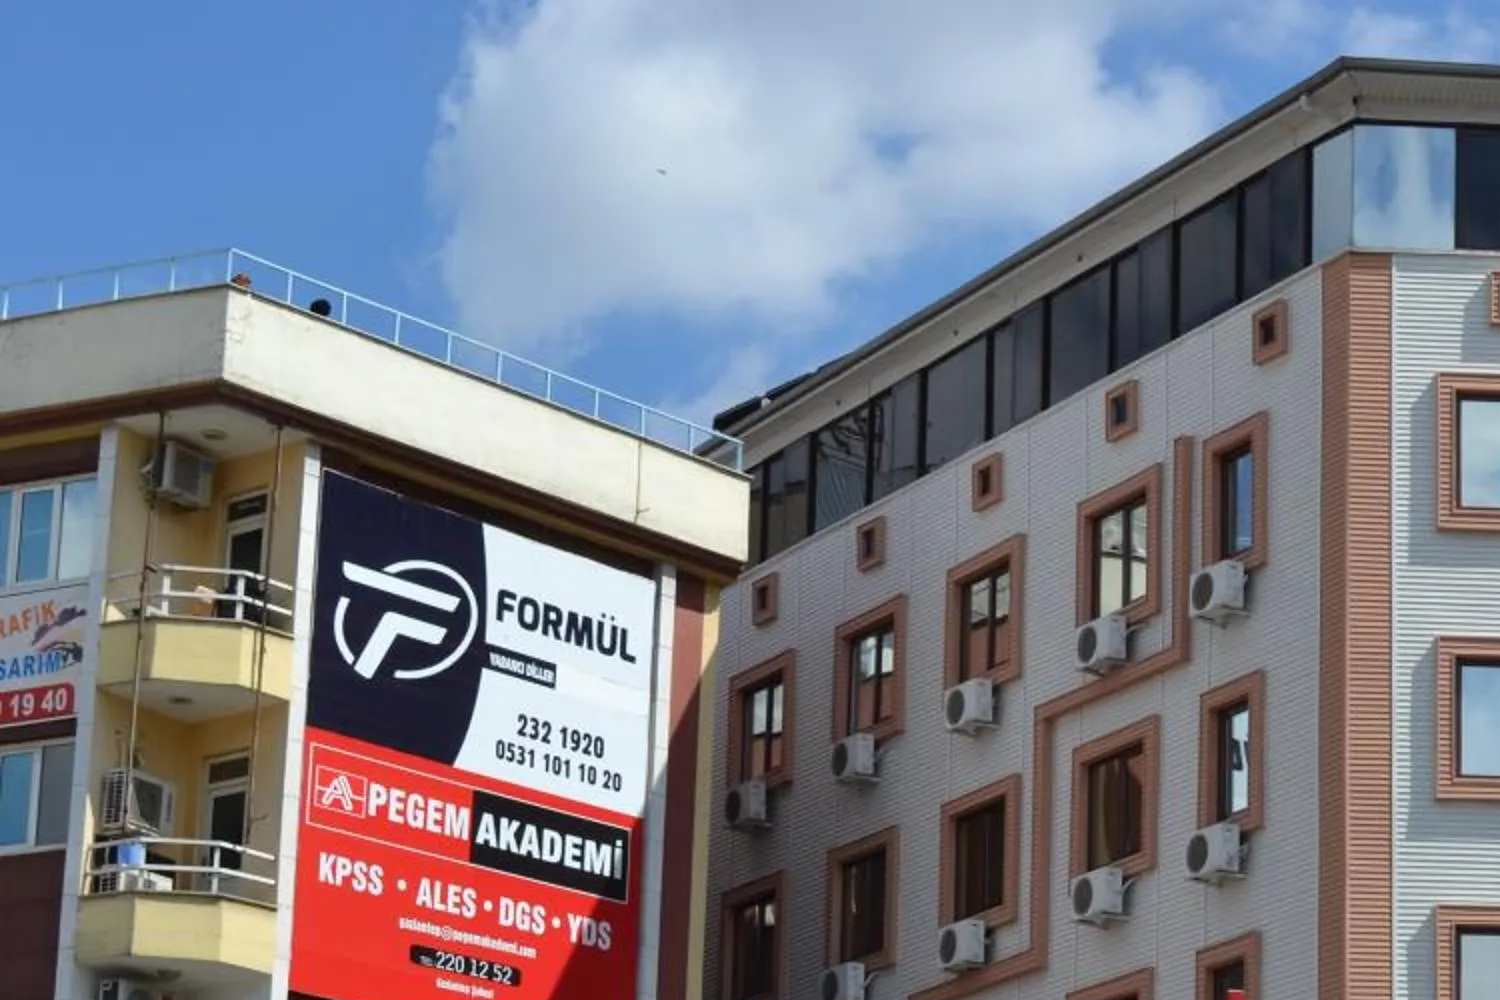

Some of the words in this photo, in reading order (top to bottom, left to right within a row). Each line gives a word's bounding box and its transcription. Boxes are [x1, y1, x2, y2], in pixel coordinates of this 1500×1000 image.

[496, 589, 636, 665] FORMÜL
[10, 692, 35, 718] 19
[41, 687, 68, 713] 40
[517, 713, 551, 745] 232
[560, 726, 605, 759] 1920
[496, 739, 535, 769] 0531
[544, 753, 571, 779] 101
[578, 763, 597, 786] 10
[602, 770, 622, 793] 20
[367, 783, 470, 842] PEGEM
[475, 811, 624, 880] AKADEMİ
[318, 851, 384, 896] KPSS
[415, 877, 478, 919] ALES
[499, 896, 546, 936] DGS
[567, 912, 612, 951] YDS
[435, 951, 465, 974] 220
[470, 957, 489, 980] 12
[491, 963, 513, 986] 52
